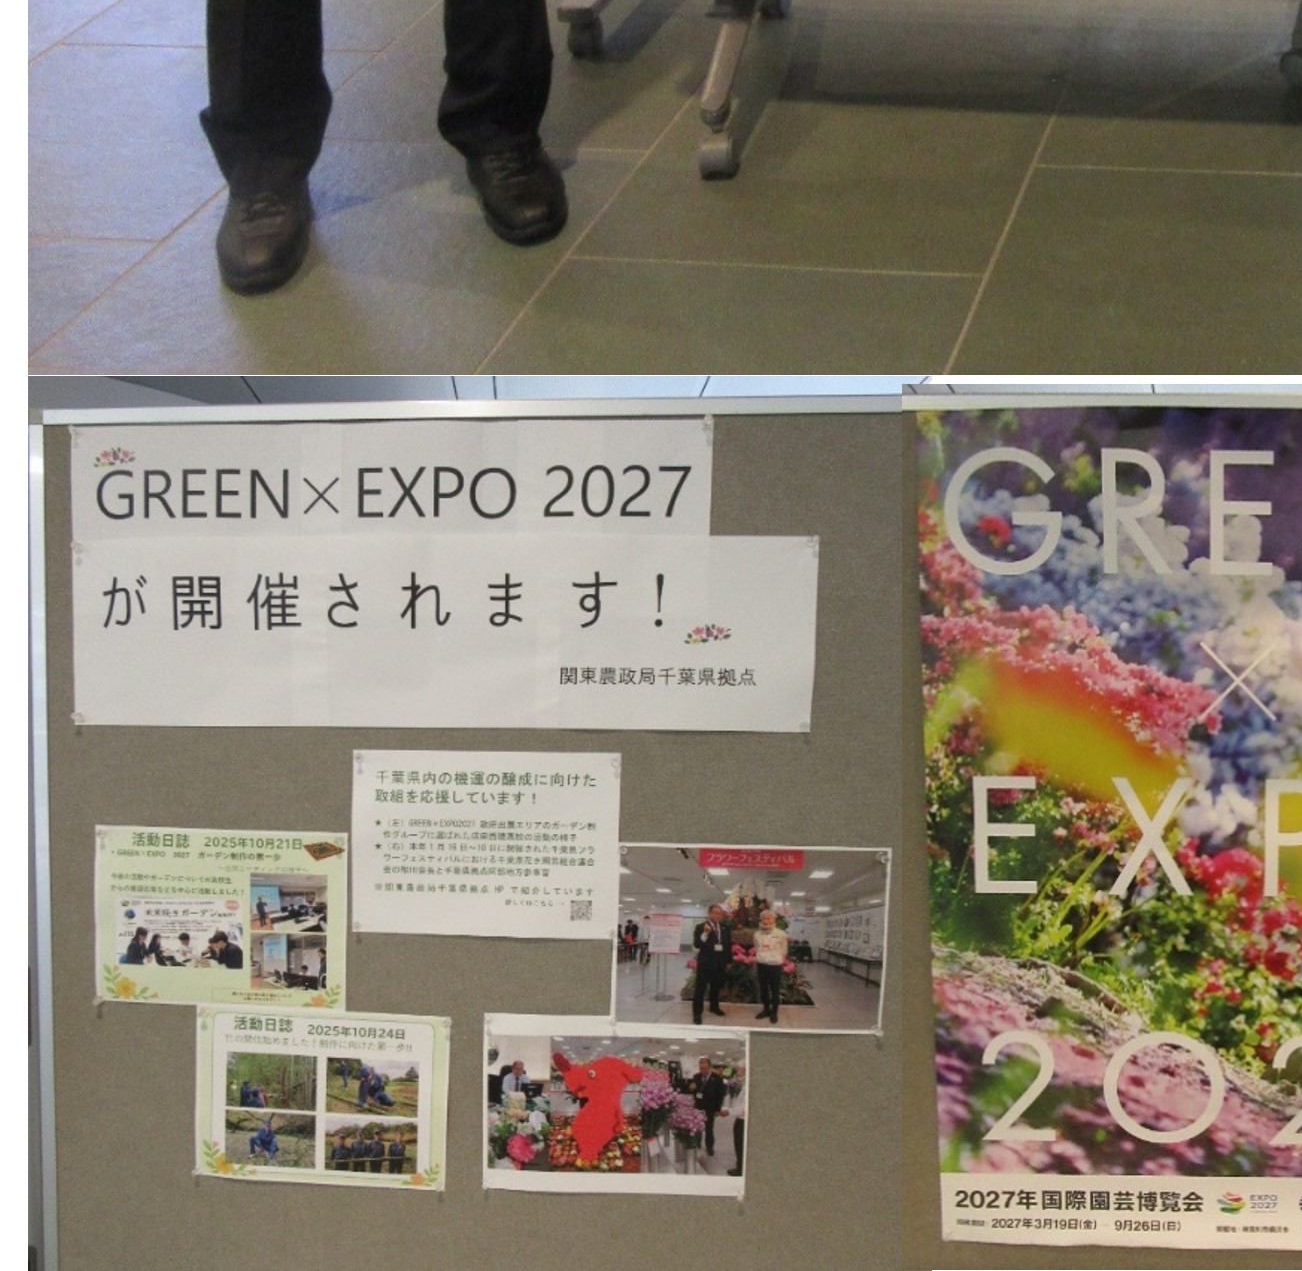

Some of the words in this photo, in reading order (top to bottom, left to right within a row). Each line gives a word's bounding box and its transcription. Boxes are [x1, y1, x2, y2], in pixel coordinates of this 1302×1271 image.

[543, 464, 693, 519] 2027
[559, 665, 756, 687] 関東農政局千葉県拠点
[376, 770, 597, 788] 千葉県内の機運の醸成に向けた
[132, 832, 190, 848] 活動日誌
[203, 836, 303, 850] 2025年10月21日
[233, 1016, 294, 1033] 活動日誌
[307, 1024, 406, 1040] 2025年10月24日
[954, 1189, 1205, 1213] 2027年国際園芸博覧会
